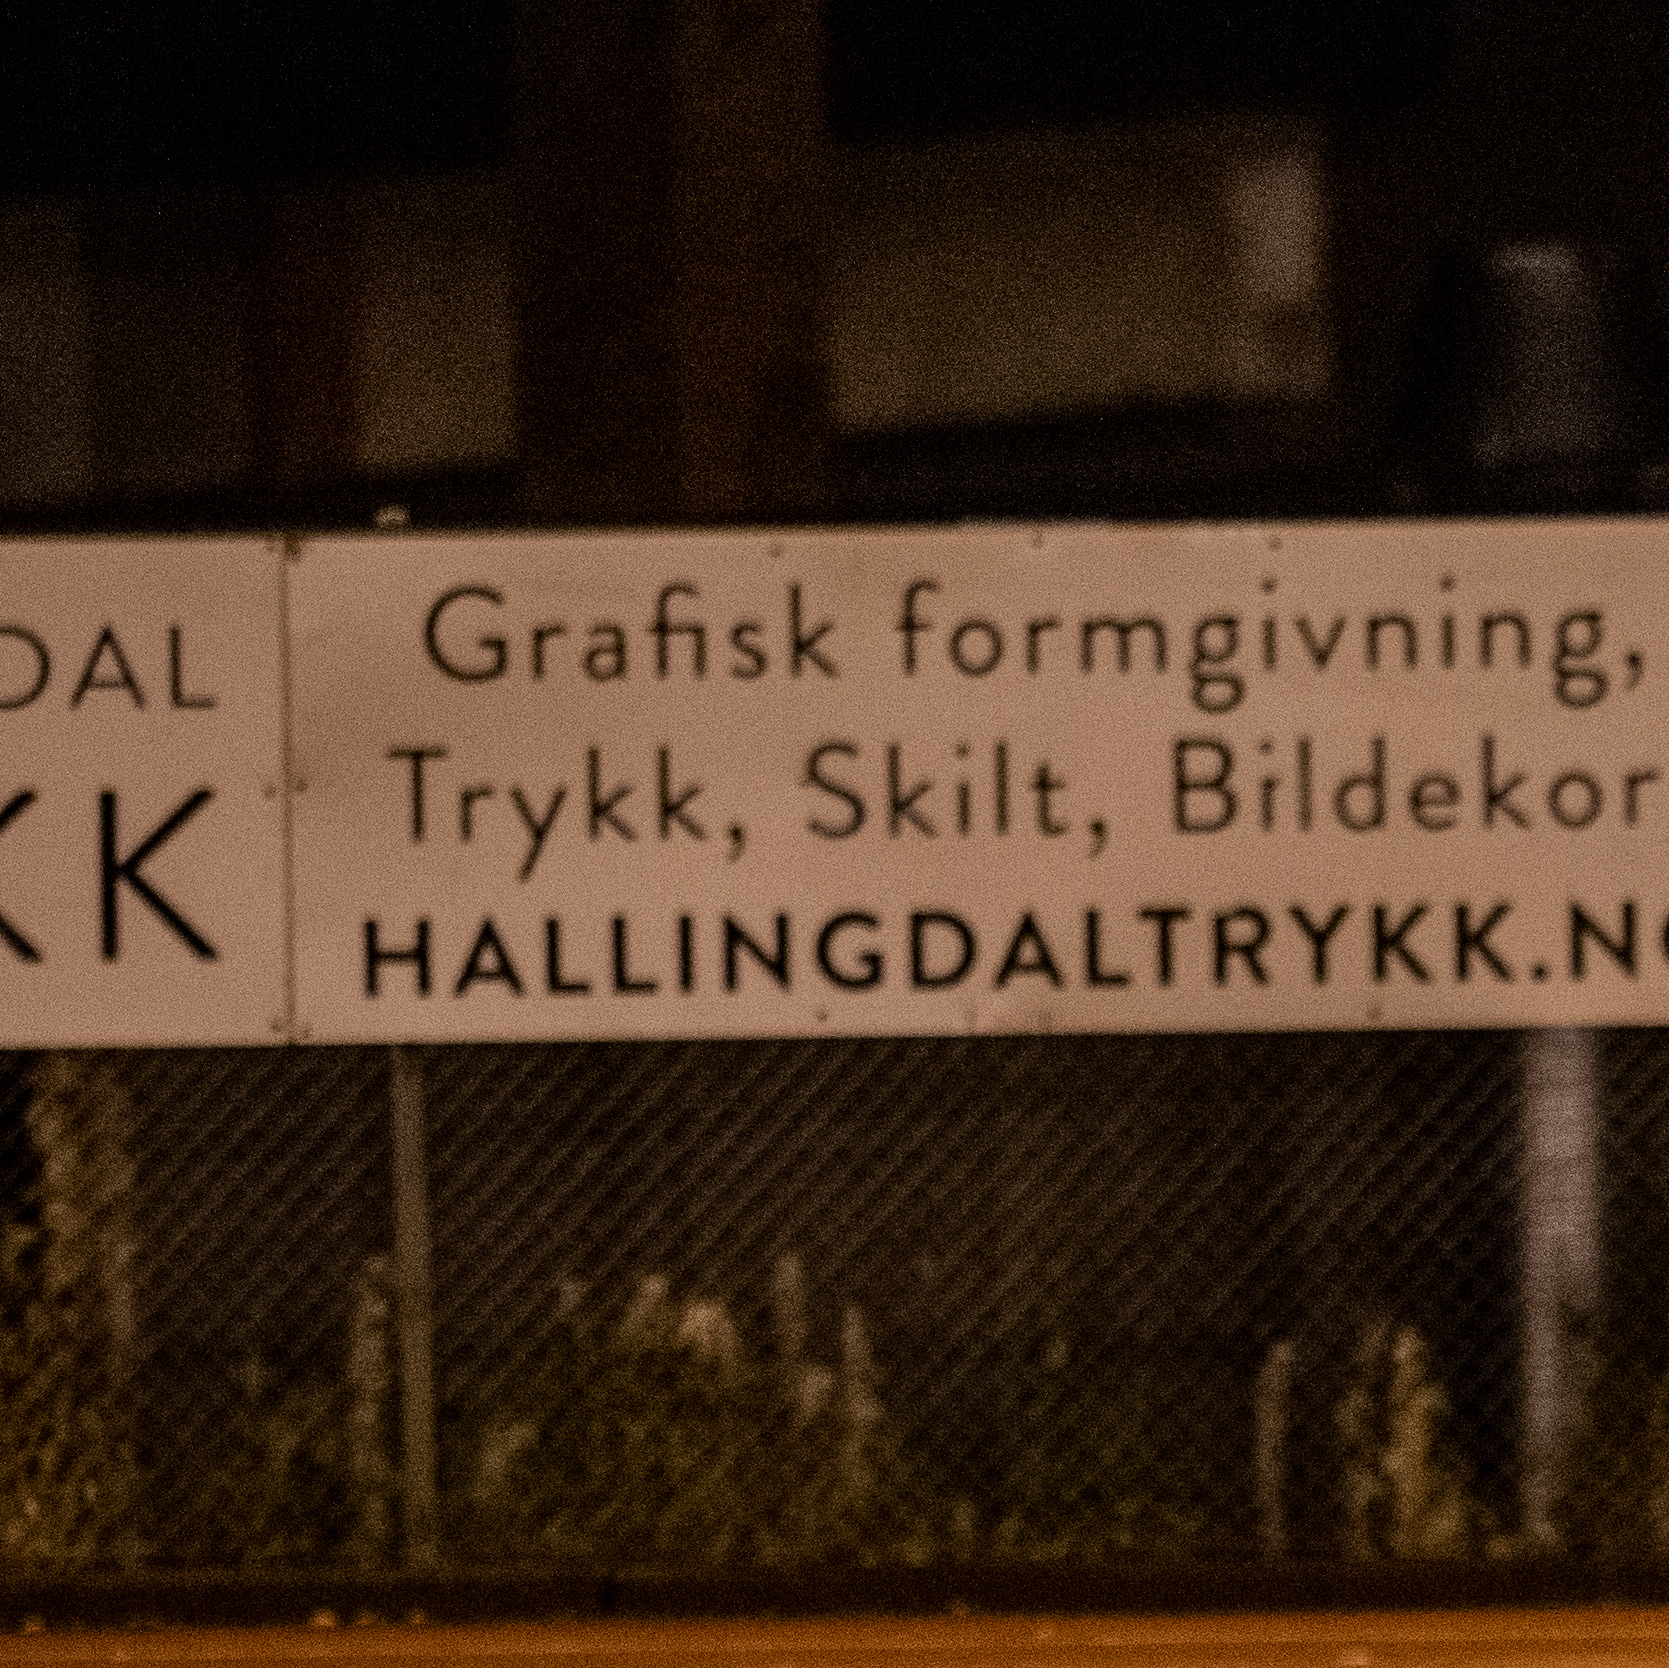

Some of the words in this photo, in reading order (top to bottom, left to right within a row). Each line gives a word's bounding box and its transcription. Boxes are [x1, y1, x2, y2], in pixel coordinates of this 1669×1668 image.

[420, 580, 839, 687] Grafisk
[894, 574, 1646, 716] formgivning,
[385, 742, 749, 883] Trykk,
[802, 737, 1110, 857] Skilt,
